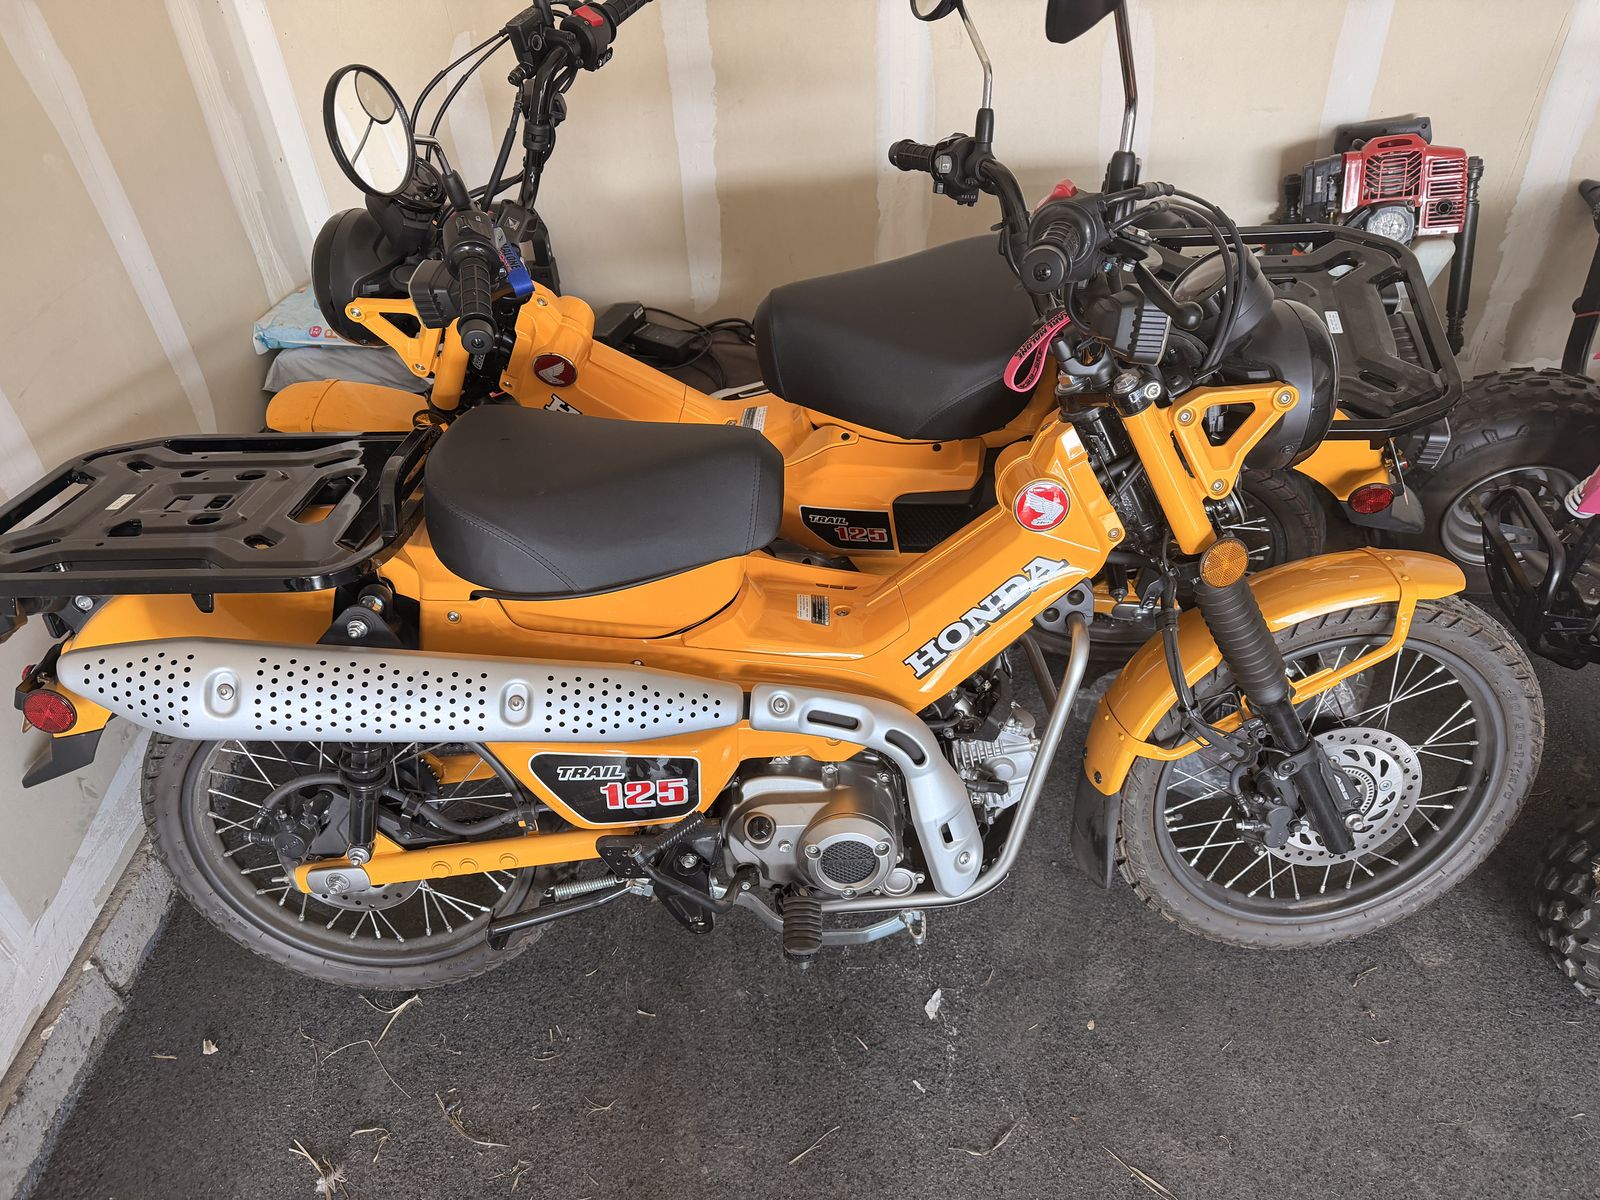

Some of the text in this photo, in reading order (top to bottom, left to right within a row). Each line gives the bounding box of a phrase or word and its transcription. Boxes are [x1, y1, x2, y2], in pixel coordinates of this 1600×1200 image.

[1016, 327, 1048, 359] MALONE
[809, 514, 848, 526] TRAIL
[834, 526, 888, 542] 125
[902, 556, 1070, 680] HONDA
[557, 765, 625, 780] TRAIL
[600, 778, 689, 810] 125
[1333, 774, 1350, 800] ABS
